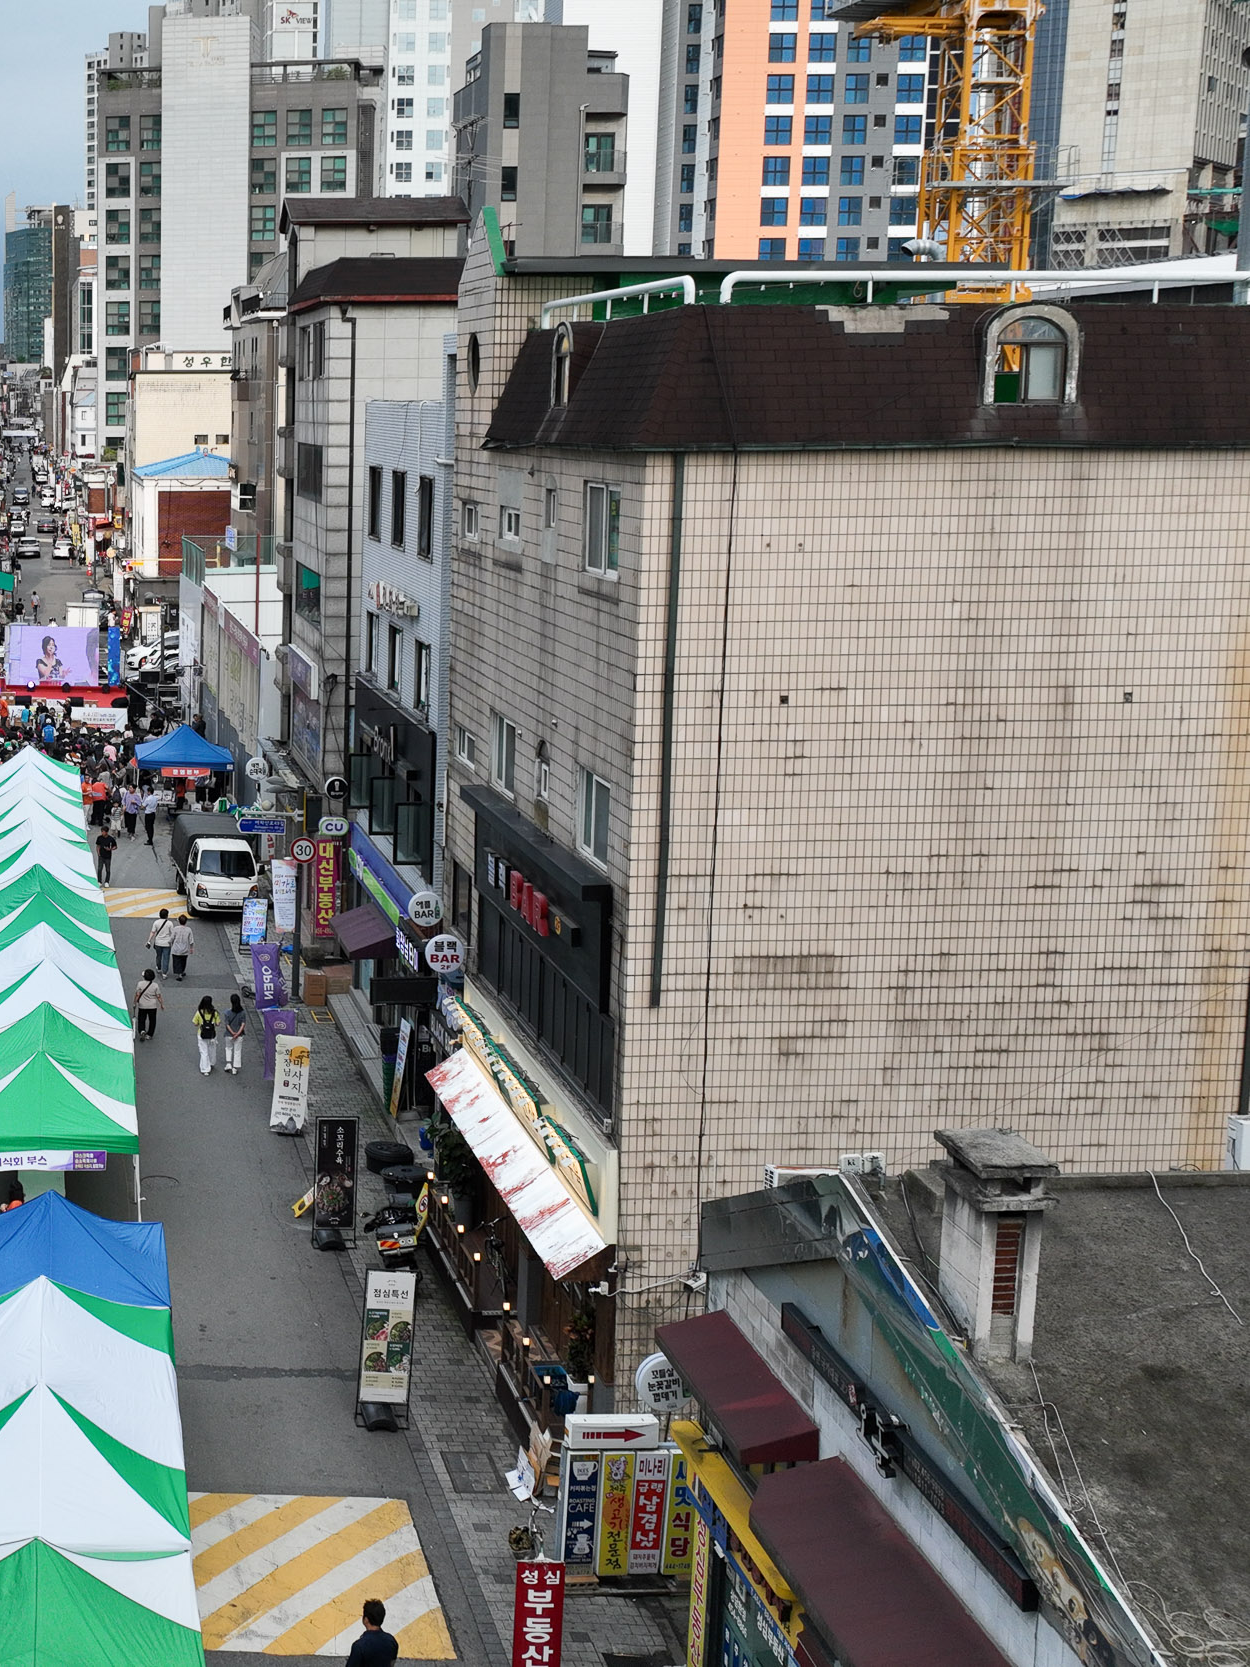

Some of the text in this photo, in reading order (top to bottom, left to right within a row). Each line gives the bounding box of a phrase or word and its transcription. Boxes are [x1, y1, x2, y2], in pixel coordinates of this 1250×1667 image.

[280, 16, 291, 24] SK
[325, 822, 344, 832] CU
[296, 844, 312, 857] 30
[317, 843, 334, 926] 대신부동산
[510, 870, 549, 937] BAR
[414, 910, 434, 919] BAR
[434, 941, 457, 953] 블랙
[430, 954, 460, 964] BAR
[283, 1048, 292, 1077] 회장님
[335, 1126, 345, 1164] 소꼬리수육
[27, 1155, 48, 1166] 부스
[373, 1288, 410, 1299] 점심특선
[651, 1367, 675, 1379] 꼬들살
[647, 1378, 681, 1392] 눈꽃갈비
[652, 1391, 678, 1403] 껍데기
[639, 1458, 666, 1475] 미나리
[570, 1484, 597, 1493] 커피볶는집
[568, 1503, 595, 1513] CAFE
[609, 1496, 625, 1530] 생고기
[635, 1496, 658, 1548] 삼겹살
[605, 1531, 623, 1570] 전문점
[521, 1570, 561, 1585] 성심
[521, 1589, 555, 1667] 부동산
